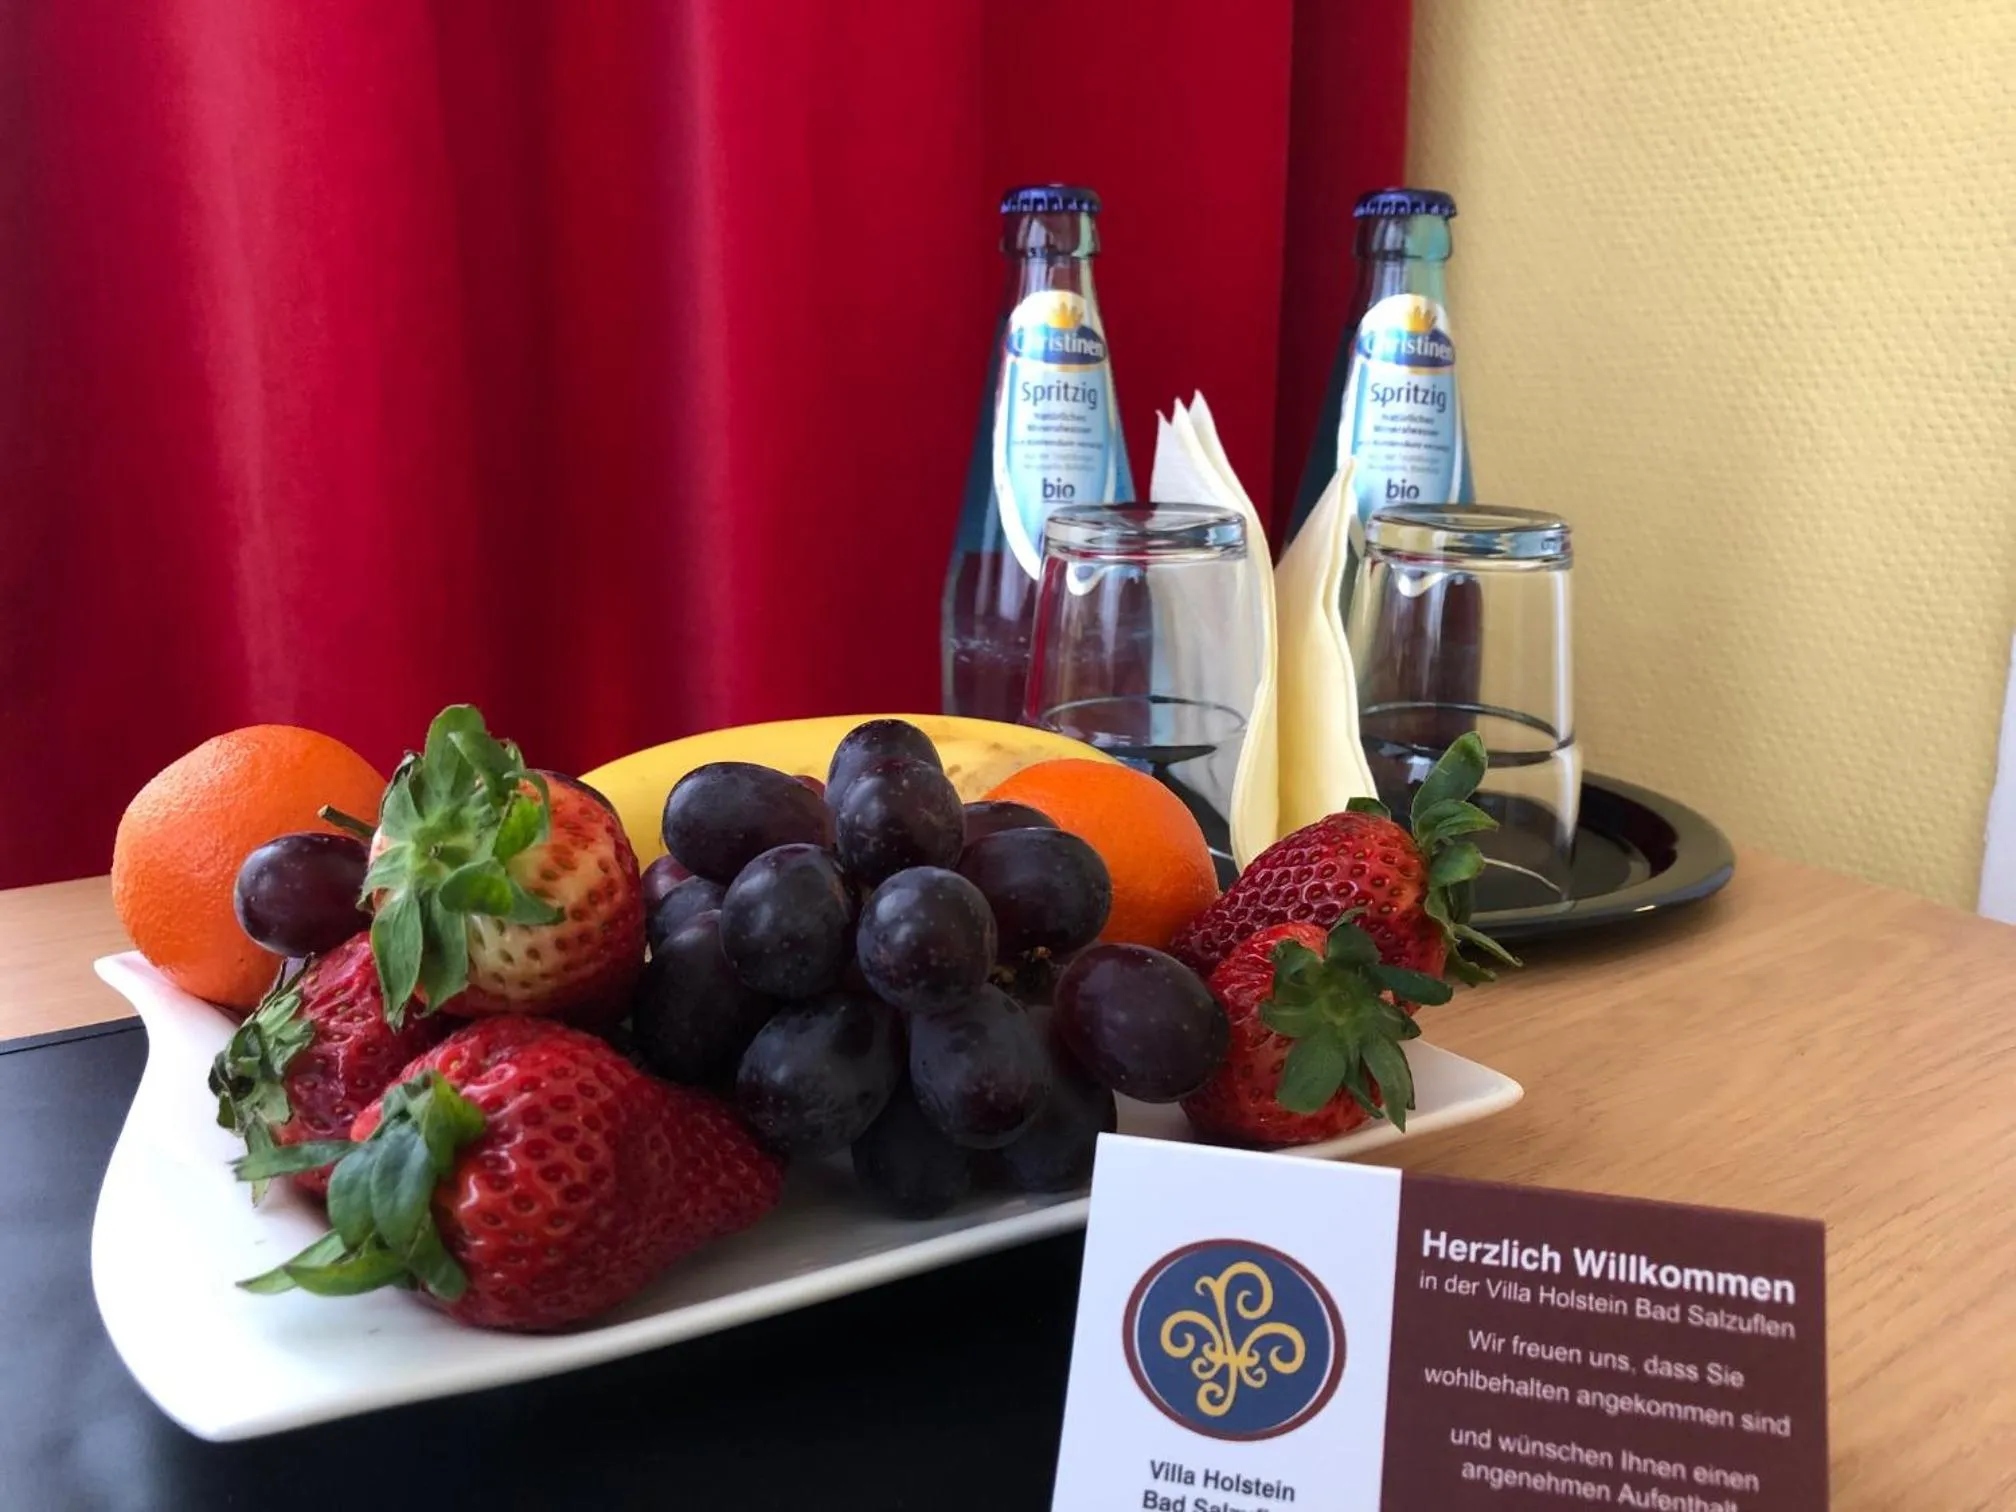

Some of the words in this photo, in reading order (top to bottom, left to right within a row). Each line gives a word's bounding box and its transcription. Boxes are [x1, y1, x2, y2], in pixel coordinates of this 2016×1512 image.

[1022, 380, 1097, 410] Spritzig
[1370, 382, 1447, 413] Spritzig
[1042, 477, 1075, 499] bio
[1386, 478, 1420, 500] bio
[1422, 1229, 1561, 1274] Herzlich
[1574, 1246, 1797, 1305] Willkommen
[1419, 1271, 1437, 1290] in
[1444, 1273, 1479, 1296] der
[1486, 1277, 1532, 1303] Villa
[1539, 1286, 1628, 1316] Holstein
[1635, 1298, 1681, 1323] Bad
[1687, 1305, 1796, 1339] Salzuflen
[1468, 1329, 1506, 1352] Wir
[1512, 1334, 1582, 1365] freuen
[1589, 1350, 1636, 1376] uns,
[1643, 1355, 1699, 1382] dass
[1706, 1362, 1745, 1388] Sie
[1424, 1365, 1570, 1402] wohlbehalten
[1576, 1386, 1734, 1428] angekommen
[1741, 1412, 1792, 1437] sind
[1451, 1425, 1492, 1450] und
[1499, 1432, 1614, 1469] wünschen
[1621, 1448, 1687, 1481] Ihnen
[1692, 1463, 1760, 1493] einen
[1142, 1489, 1187, 1512] Bad
[1150, 1459, 1196, 1485] Villa
[1203, 1468, 1295, 1502] Holstein
[1461, 1460, 1611, 1502] angenehmen
